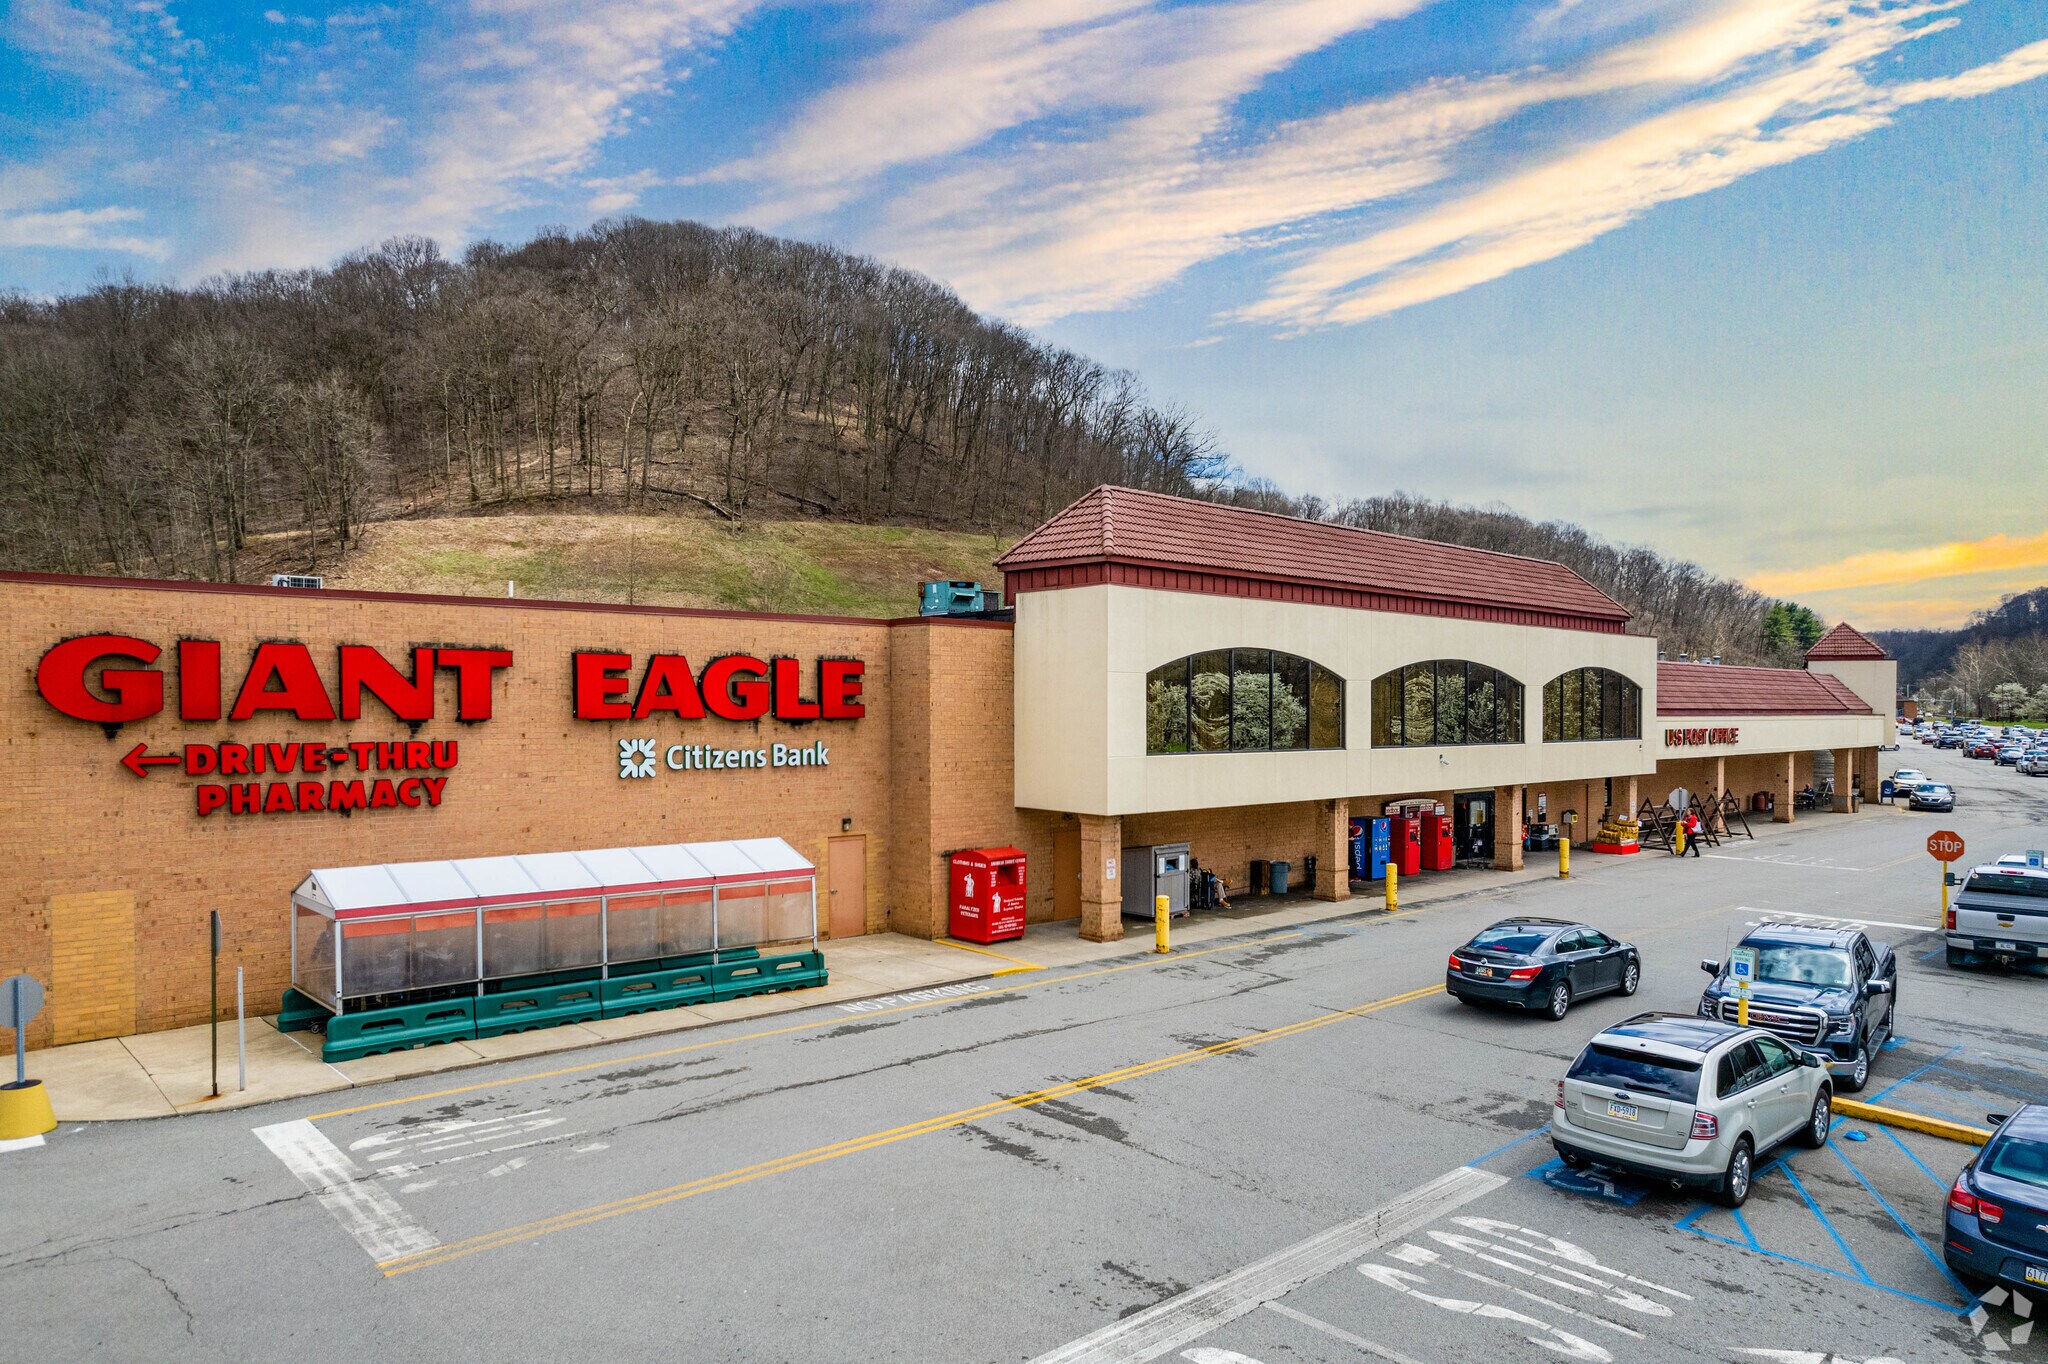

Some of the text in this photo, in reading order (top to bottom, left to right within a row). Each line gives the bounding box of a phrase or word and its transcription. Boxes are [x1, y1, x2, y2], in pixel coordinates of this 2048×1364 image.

[36, 633, 866, 723] GIANT EAGLE
[1683, 728, 1708, 745] POST
[1709, 727, 1739, 744] OFFICE
[185, 740, 458, 776] DRIVE-THRU
[666, 741, 830, 770] Citizens Bank
[196, 777, 449, 816] PHARMACY
[1354, 841, 1362, 870] pepsi
[1929, 839, 1963, 853] STOP
[959, 904, 980, 912] PARALYZED
[960, 911, 979, 919] VETERANS
[1733, 950, 1753, 958] RESERVED
[835, 982, 990, 1013] NO PARKING
[1750, 1011, 1789, 1024] GMC
[1355, 1215, 1696, 1364] STOP
